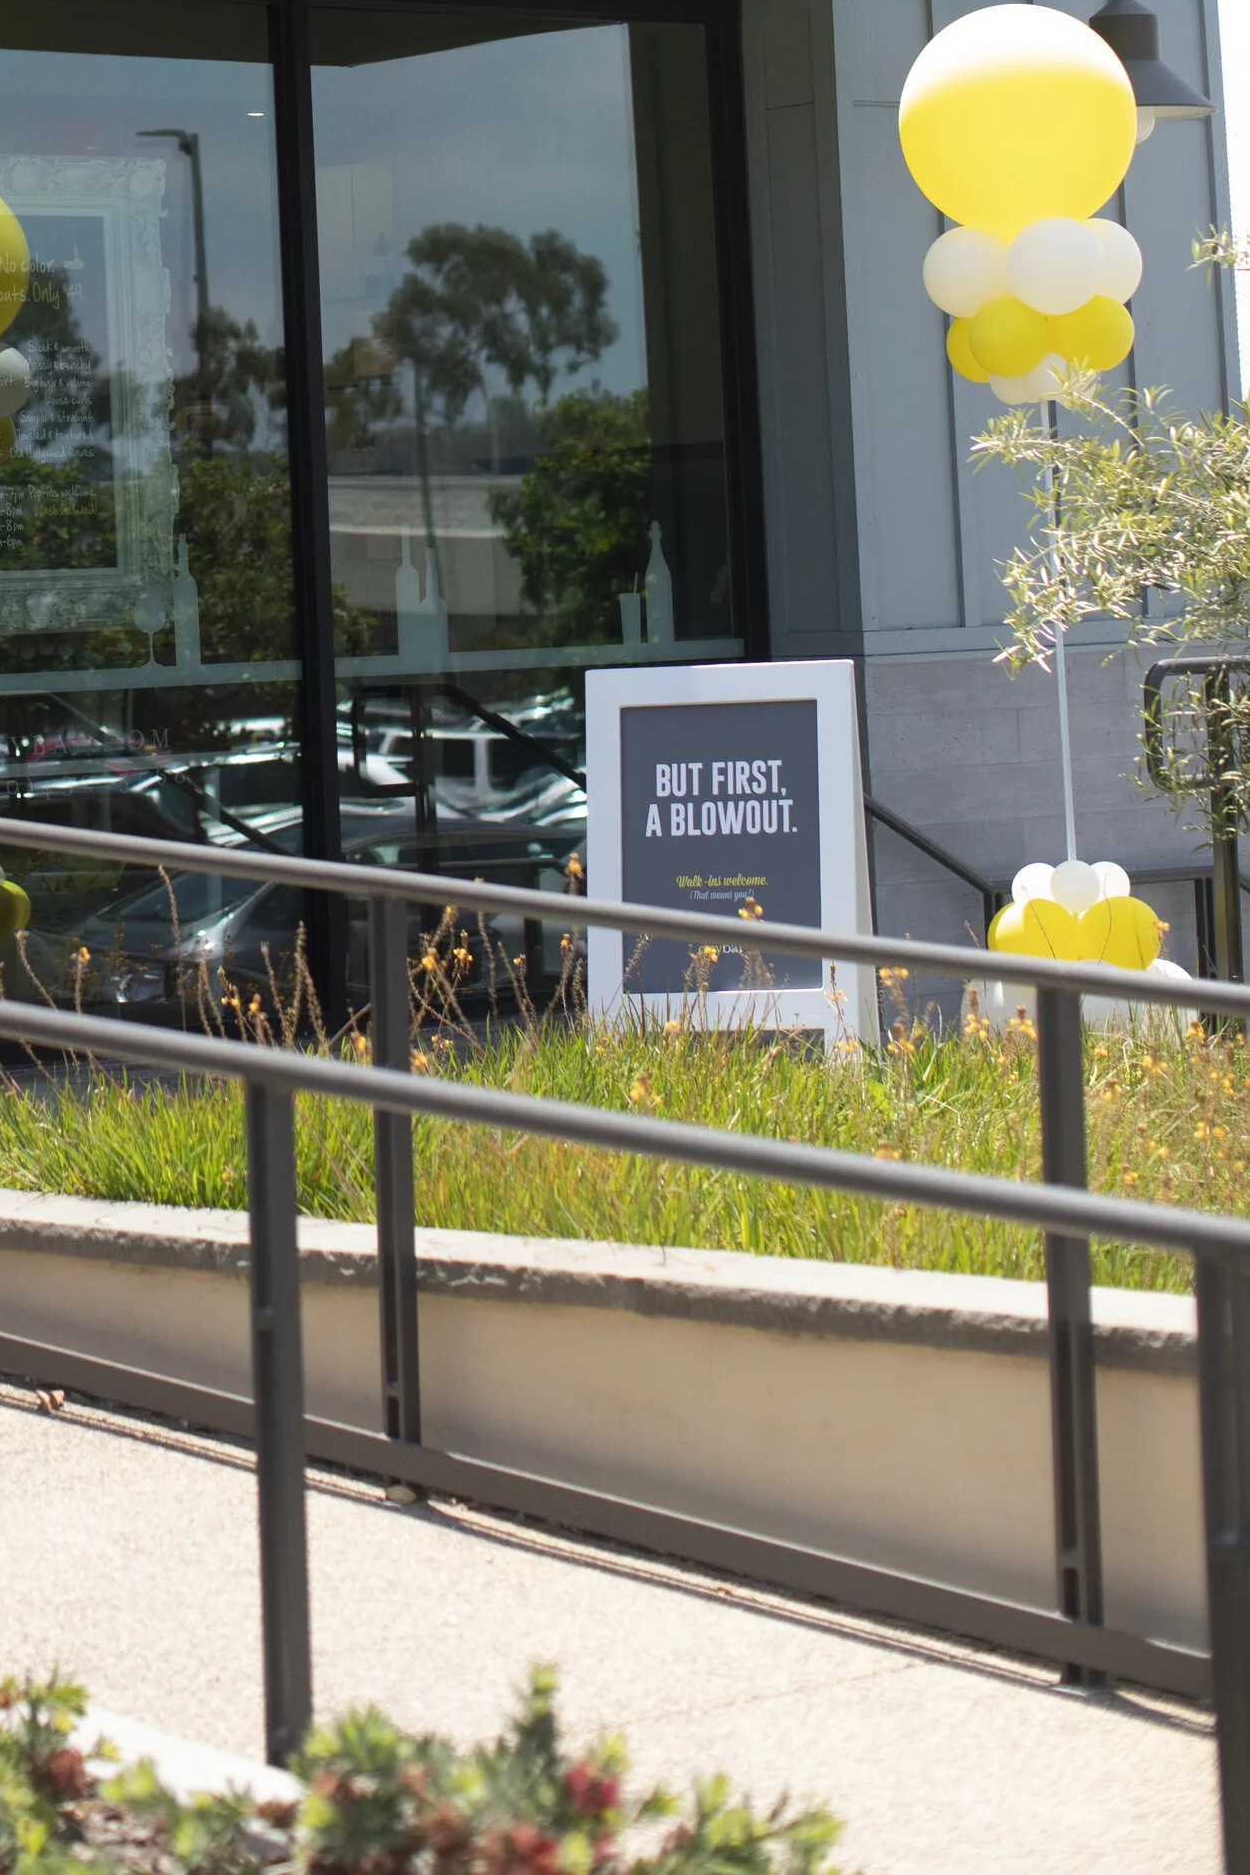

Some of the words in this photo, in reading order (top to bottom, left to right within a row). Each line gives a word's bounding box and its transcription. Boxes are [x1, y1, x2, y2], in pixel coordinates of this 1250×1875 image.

[21, 251, 55, 273] color.
[32, 280, 60, 309] Only
[655, 762, 703, 798] BUT
[711, 759, 787, 797] FIRST,
[645, 803, 663, 838] A
[670, 798, 798, 837] BLOWOUT.
[675, 874, 722, 889] Walk-ins
[723, 873, 768, 887] welcome.
[710, 890, 733, 900] means
